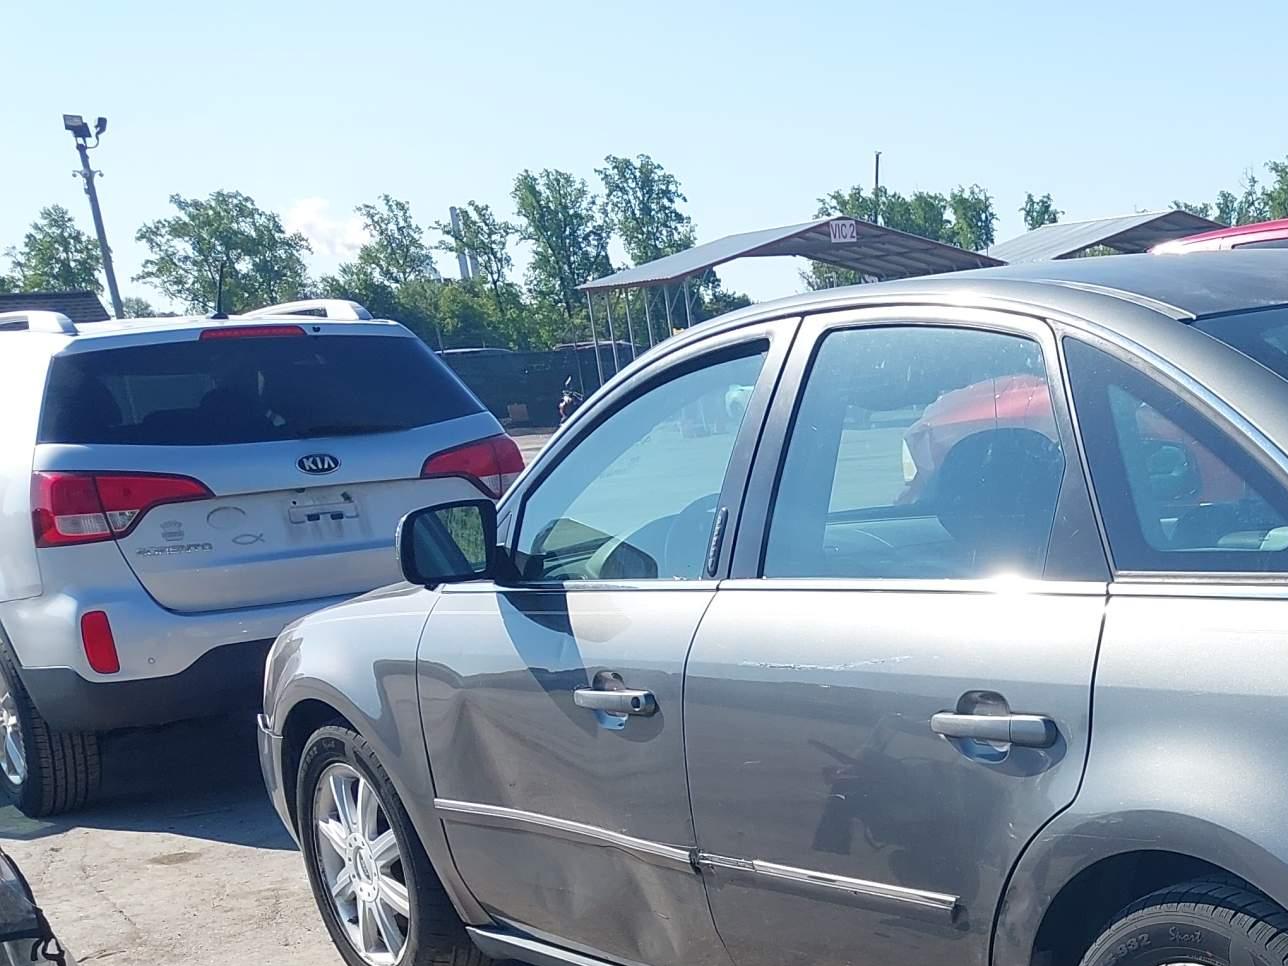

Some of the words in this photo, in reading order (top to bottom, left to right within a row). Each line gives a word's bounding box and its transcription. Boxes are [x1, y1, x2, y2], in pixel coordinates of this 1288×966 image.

[830, 223, 848, 239] VIC
[849, 223, 856, 239] 2
[302, 455, 336, 470] KIA
